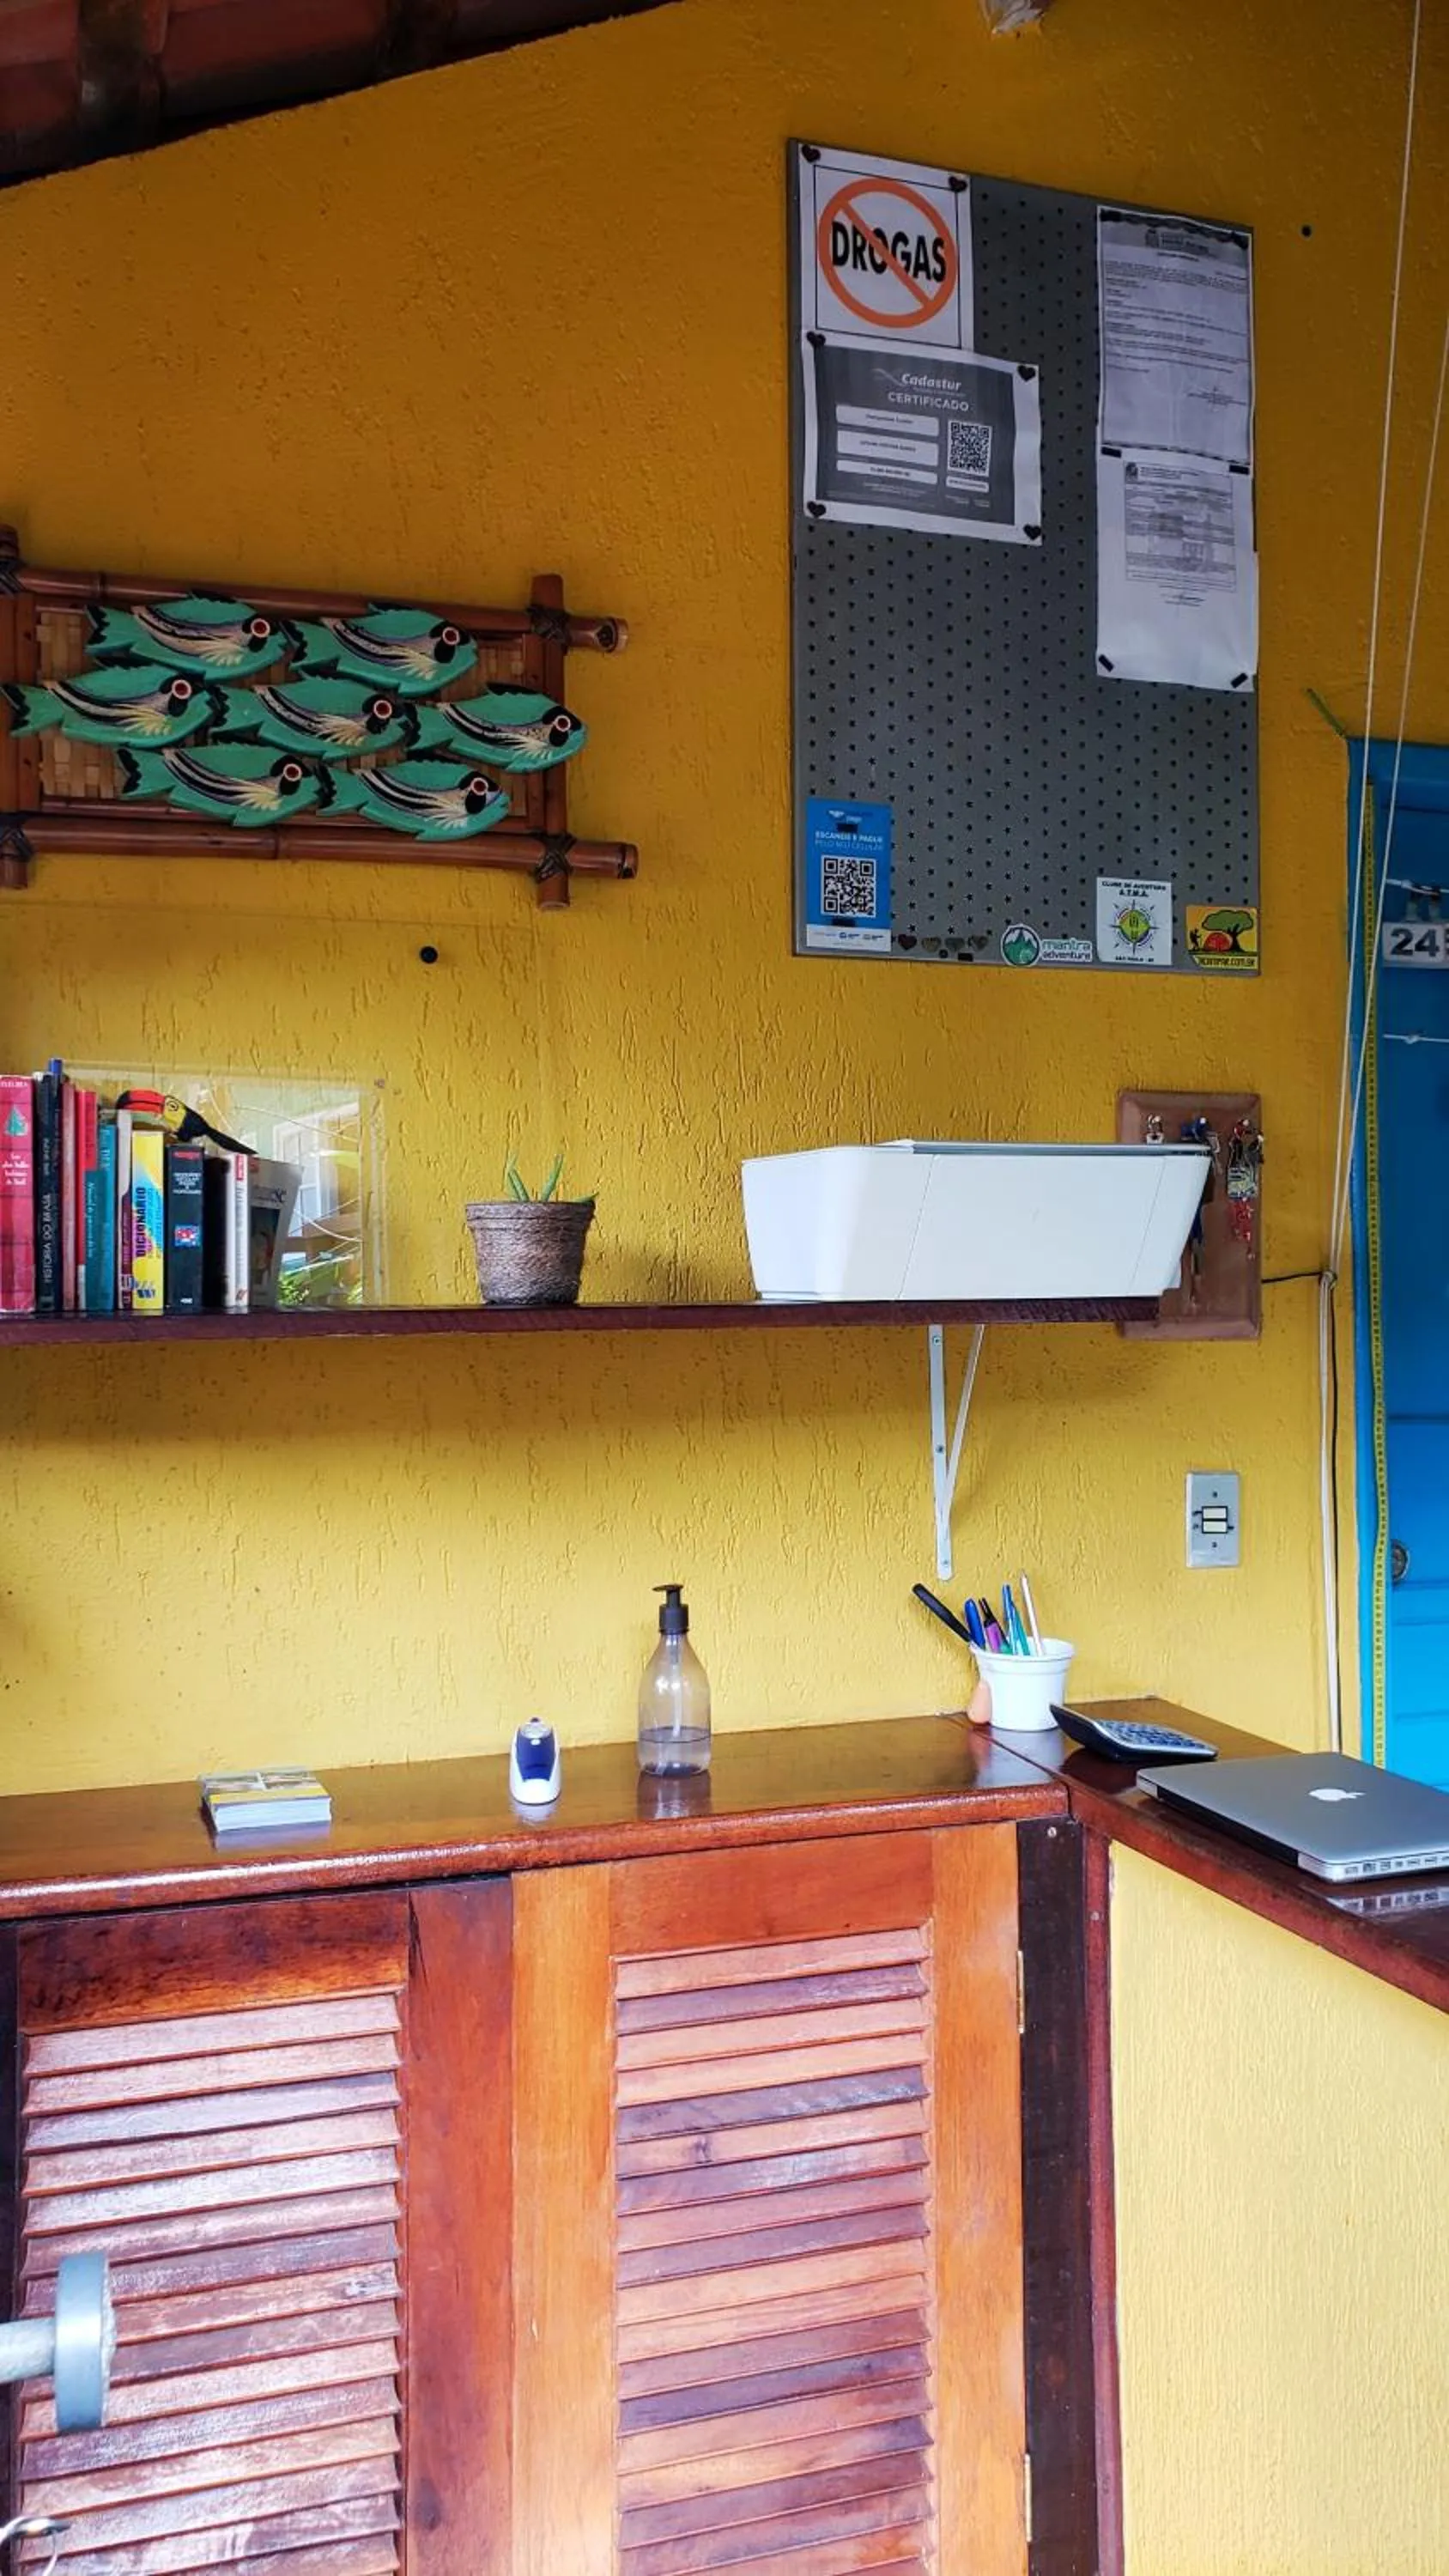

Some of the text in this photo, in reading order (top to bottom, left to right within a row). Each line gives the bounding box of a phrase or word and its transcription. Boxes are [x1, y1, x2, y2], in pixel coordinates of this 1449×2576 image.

[831, 221, 946, 283] DROGAS
[901, 373, 962, 391] Cadastur
[888, 392, 970, 412] CERTIFICADO
[1390, 927, 1449, 958] 24
